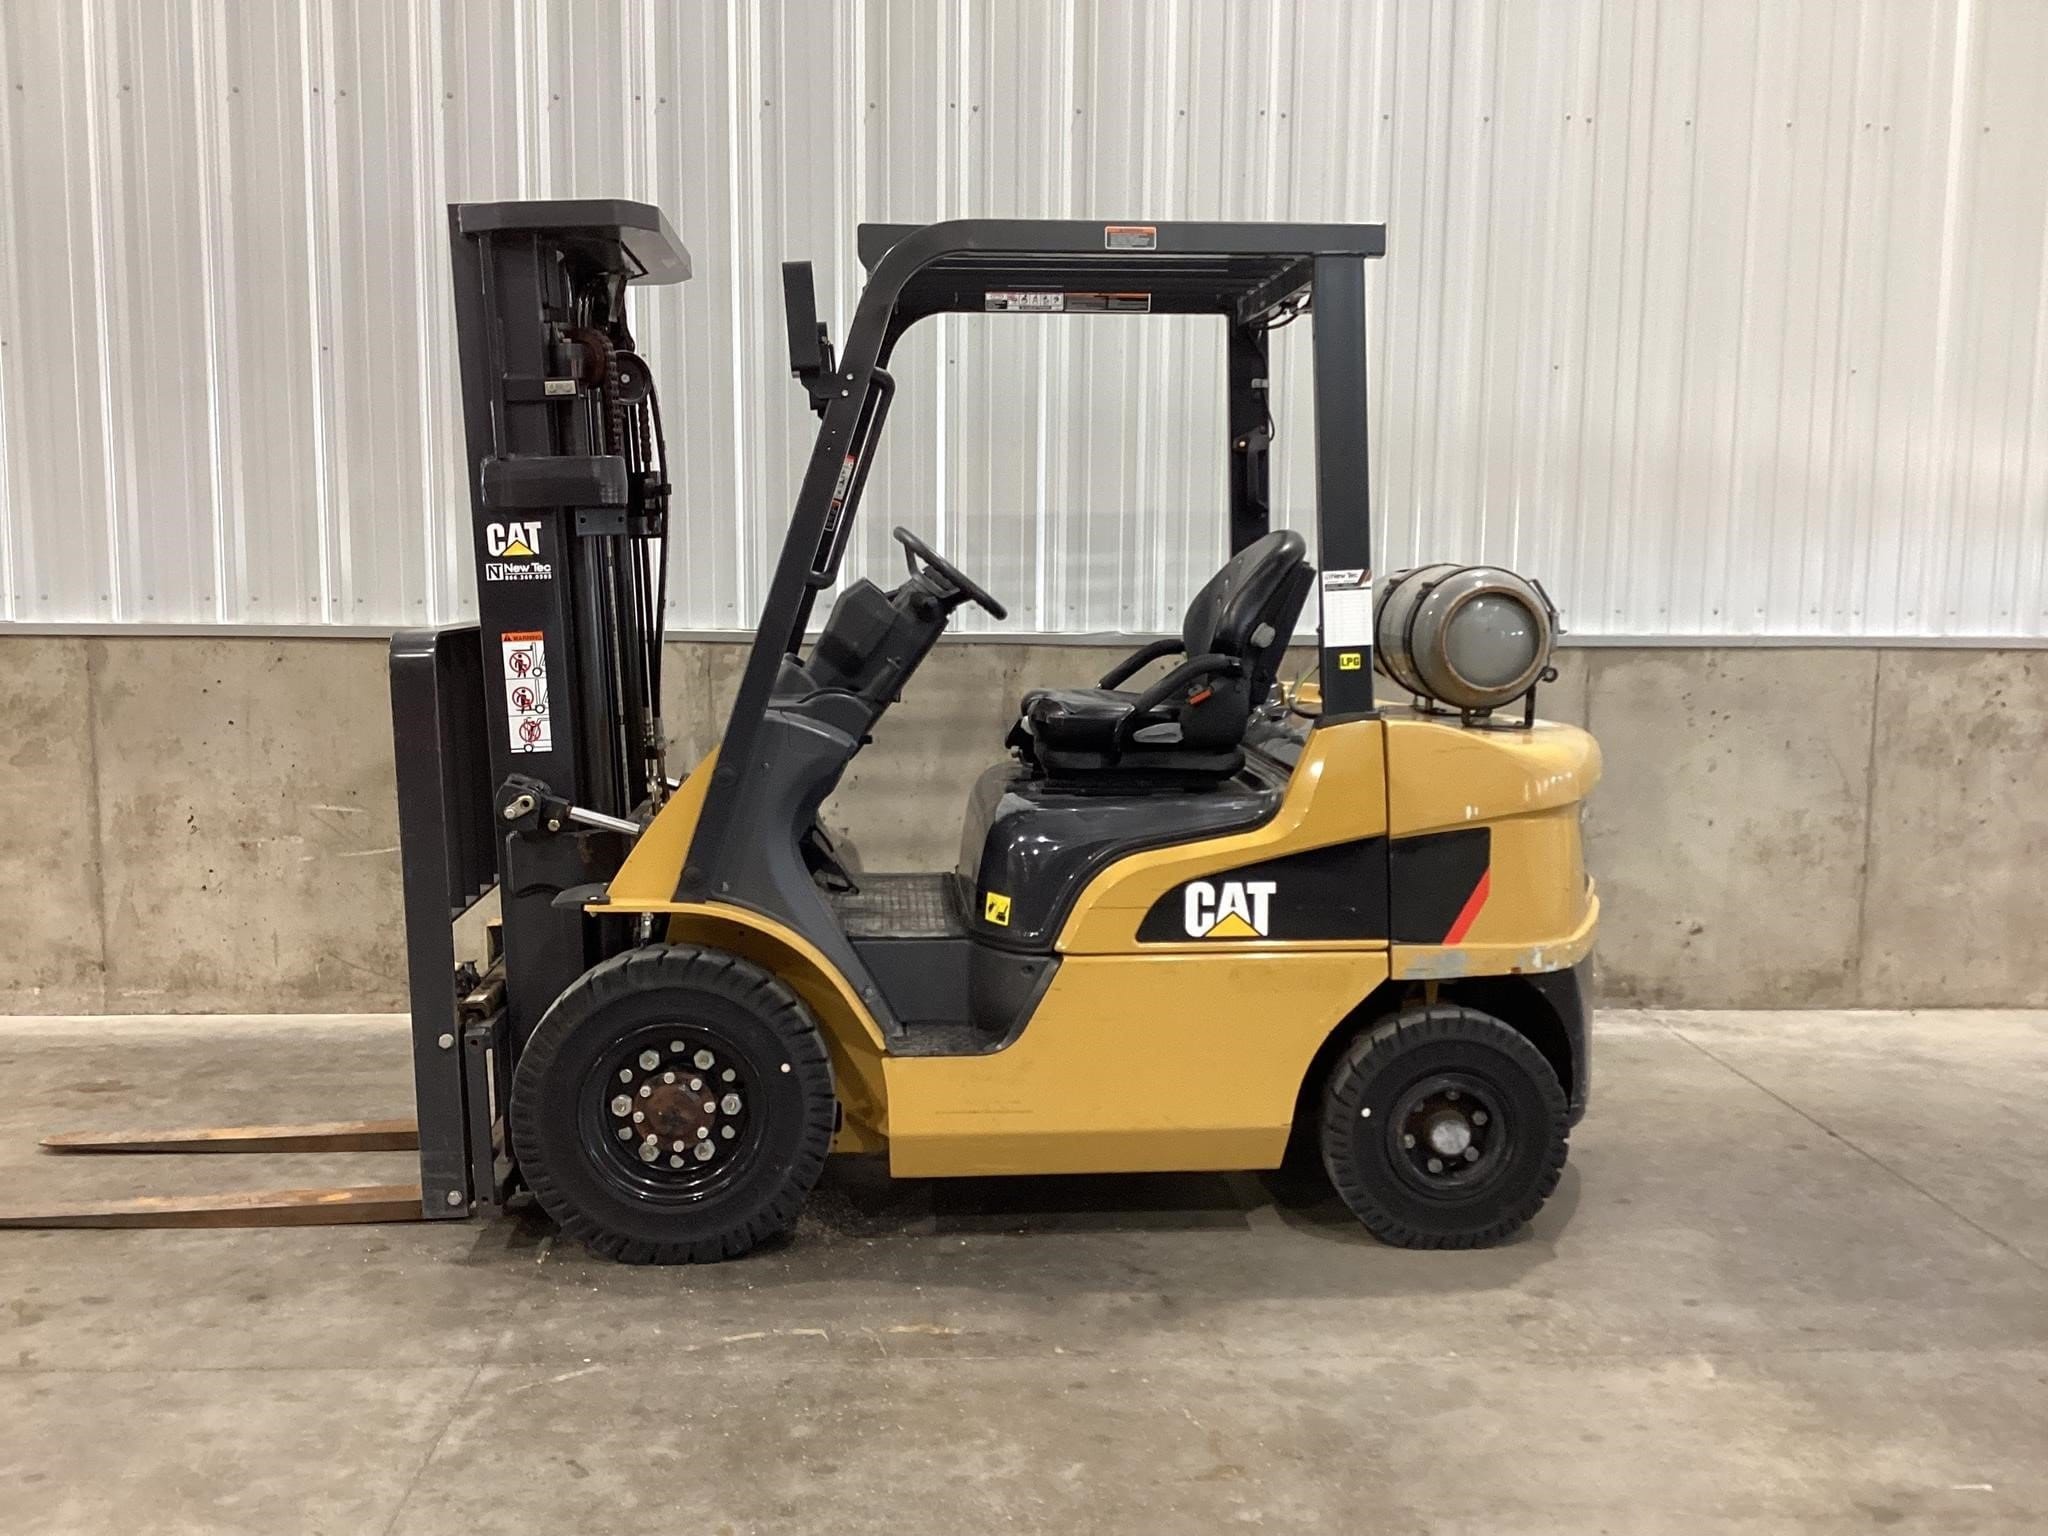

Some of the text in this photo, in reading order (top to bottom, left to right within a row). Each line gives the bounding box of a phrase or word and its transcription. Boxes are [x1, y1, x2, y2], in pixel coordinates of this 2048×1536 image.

[486, 521, 542, 557] CAT
[504, 563, 530, 573] New
[531, 562, 552, 572] Tec
[1341, 656, 1360, 667] LPG
[1184, 880, 1277, 938] CAT
